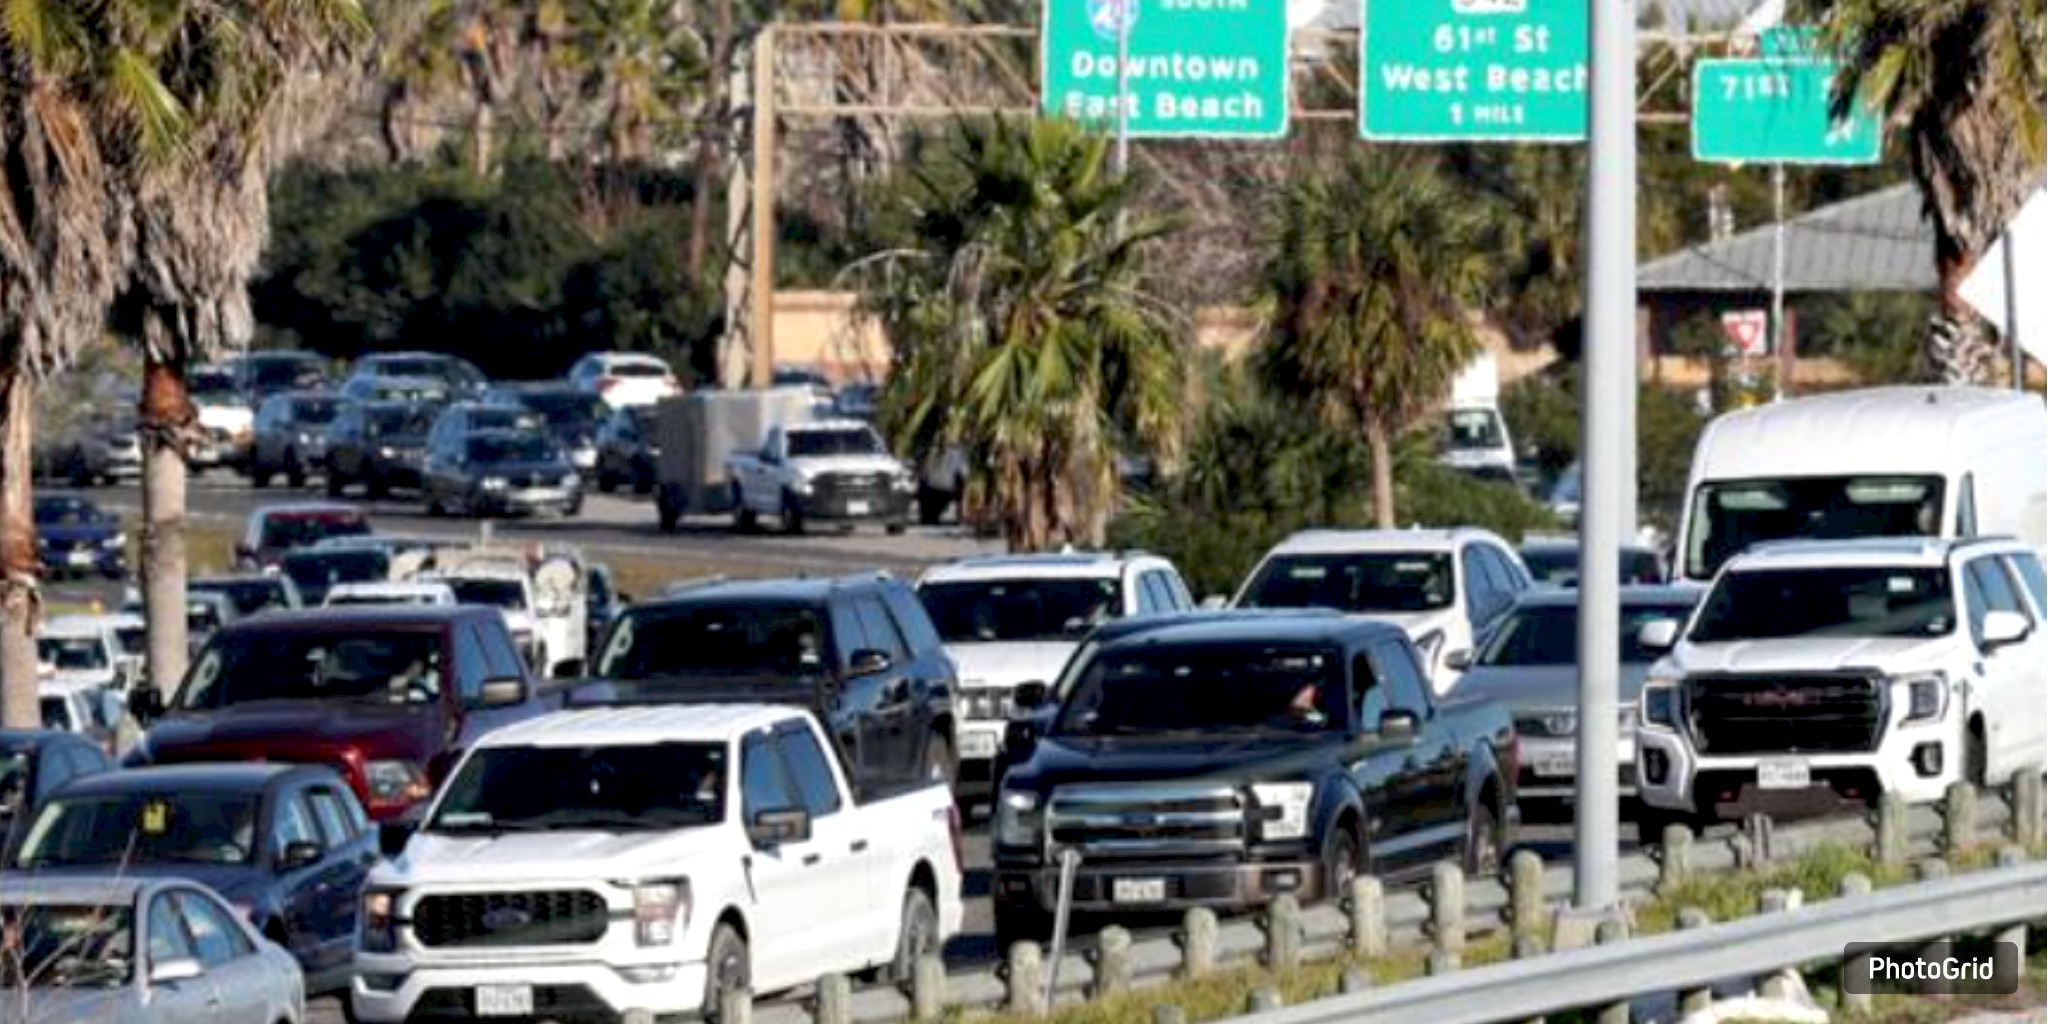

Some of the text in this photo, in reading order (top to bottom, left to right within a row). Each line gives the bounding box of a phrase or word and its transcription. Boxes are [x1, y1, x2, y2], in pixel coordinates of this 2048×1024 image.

[1514, 25, 1549, 52] St
[1072, 51, 1259, 80] Downtown
[1381, 64, 1468, 91] West
[1156, 92, 1262, 118] Beach
[1450, 102, 1524, 124] 1 MILE
